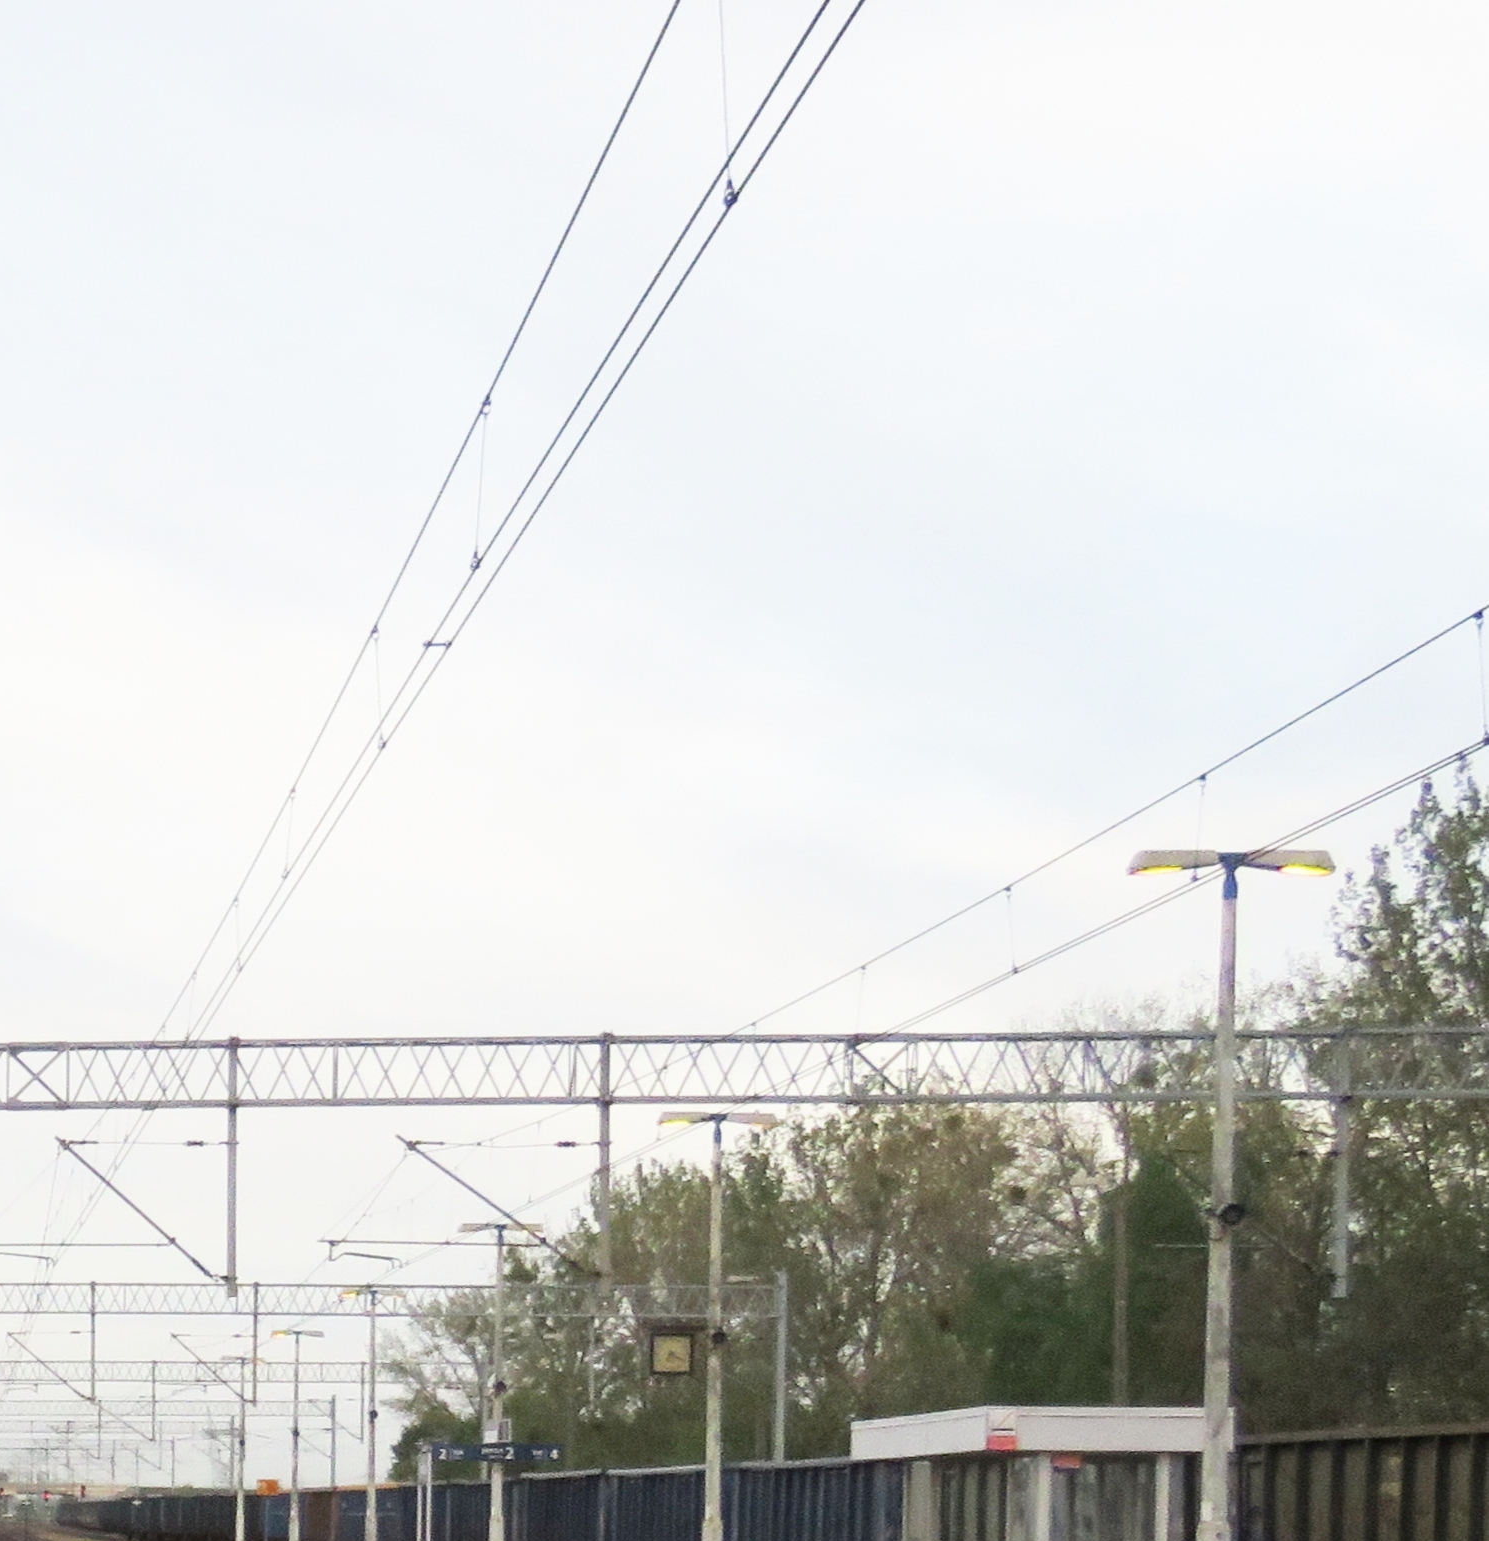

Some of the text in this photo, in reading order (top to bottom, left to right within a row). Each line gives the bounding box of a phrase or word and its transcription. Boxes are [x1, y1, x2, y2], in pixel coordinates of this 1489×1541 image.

[438, 1448, 448, 1460] 2
[504, 1447, 515, 1460] 2
[549, 1449, 559, 1460] 4
